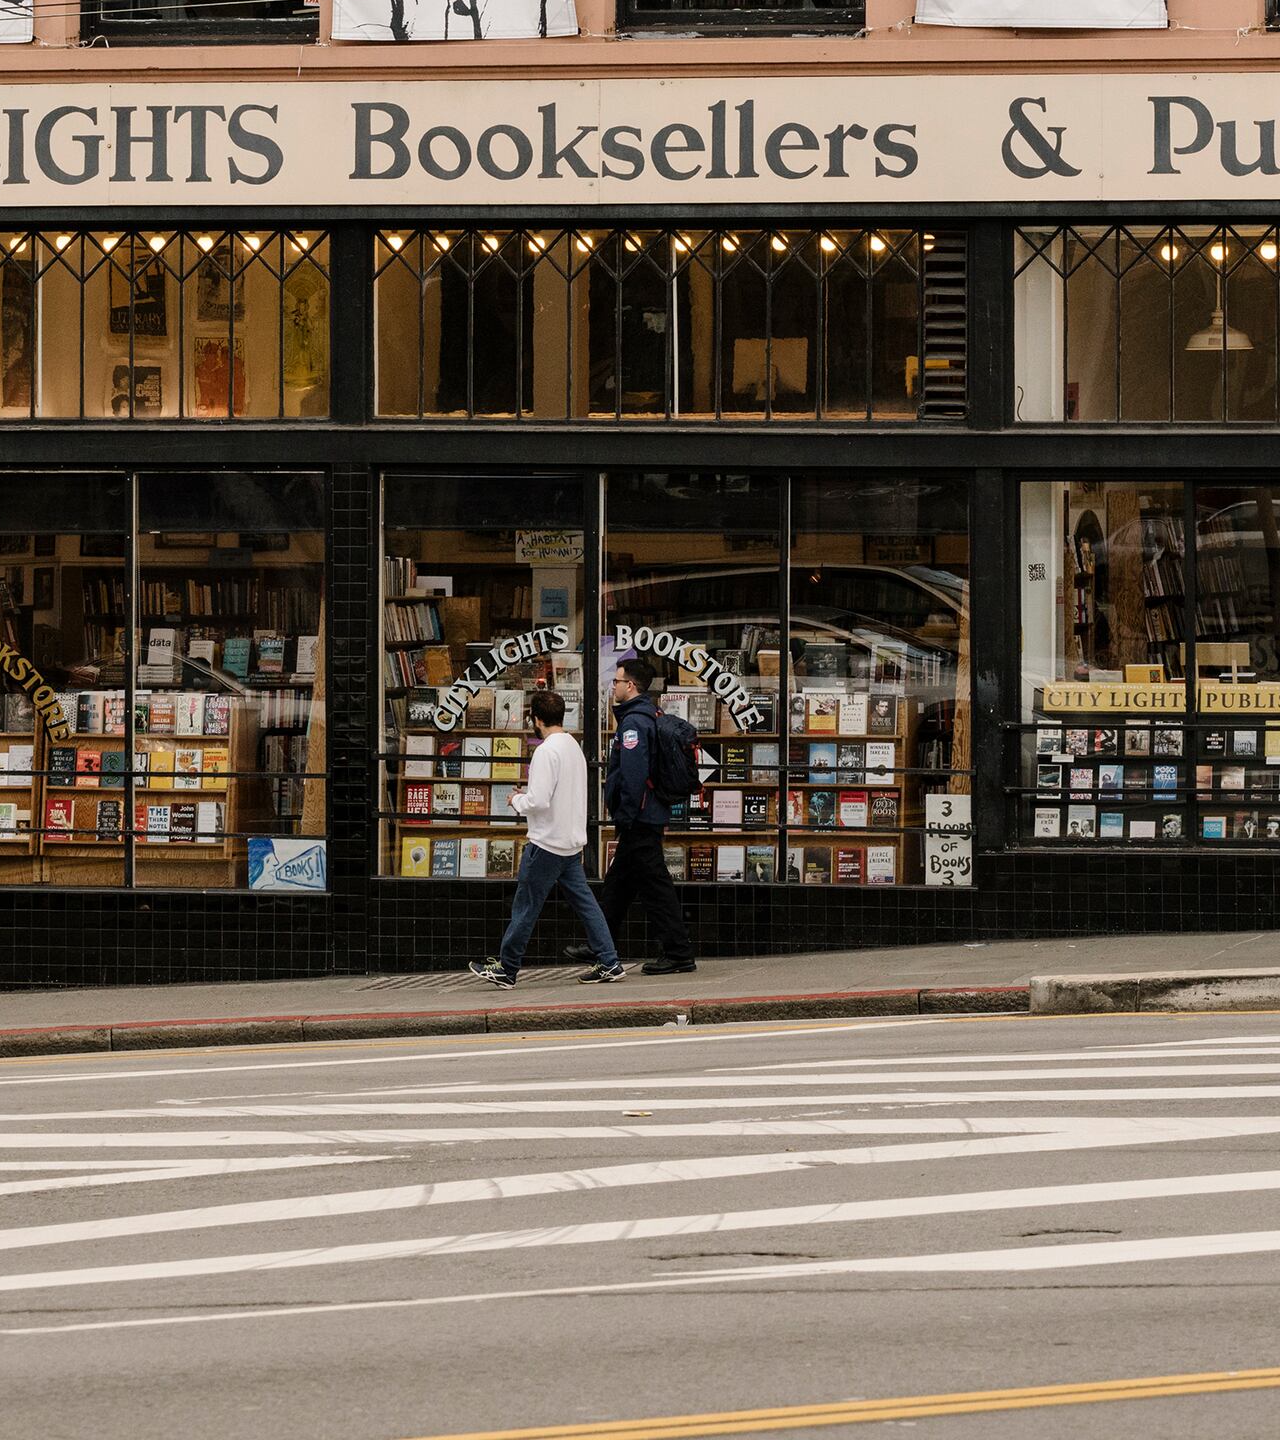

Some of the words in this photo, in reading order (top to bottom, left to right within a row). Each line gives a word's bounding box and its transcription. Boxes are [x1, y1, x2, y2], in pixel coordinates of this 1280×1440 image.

[348, 97, 919, 181] Booksellers
[1001, 95, 1082, 179] &
[149, 638, 171, 647] data
[433, 667, 480, 732] CITY
[474, 625, 569, 682] LIGHTS
[615, 624, 764, 731] BOOKSTORE
[662, 694, 686, 702] SOLITARY
[1047, 691, 1102, 708] CITY
[407, 791, 428, 799] RAGE
[149, 807, 168, 816] THE
[745, 805, 766, 813] ICE
[941, 801, 952, 817] 3
[941, 842, 958, 852] OF
[284, 853, 320, 881] BOOKS!
